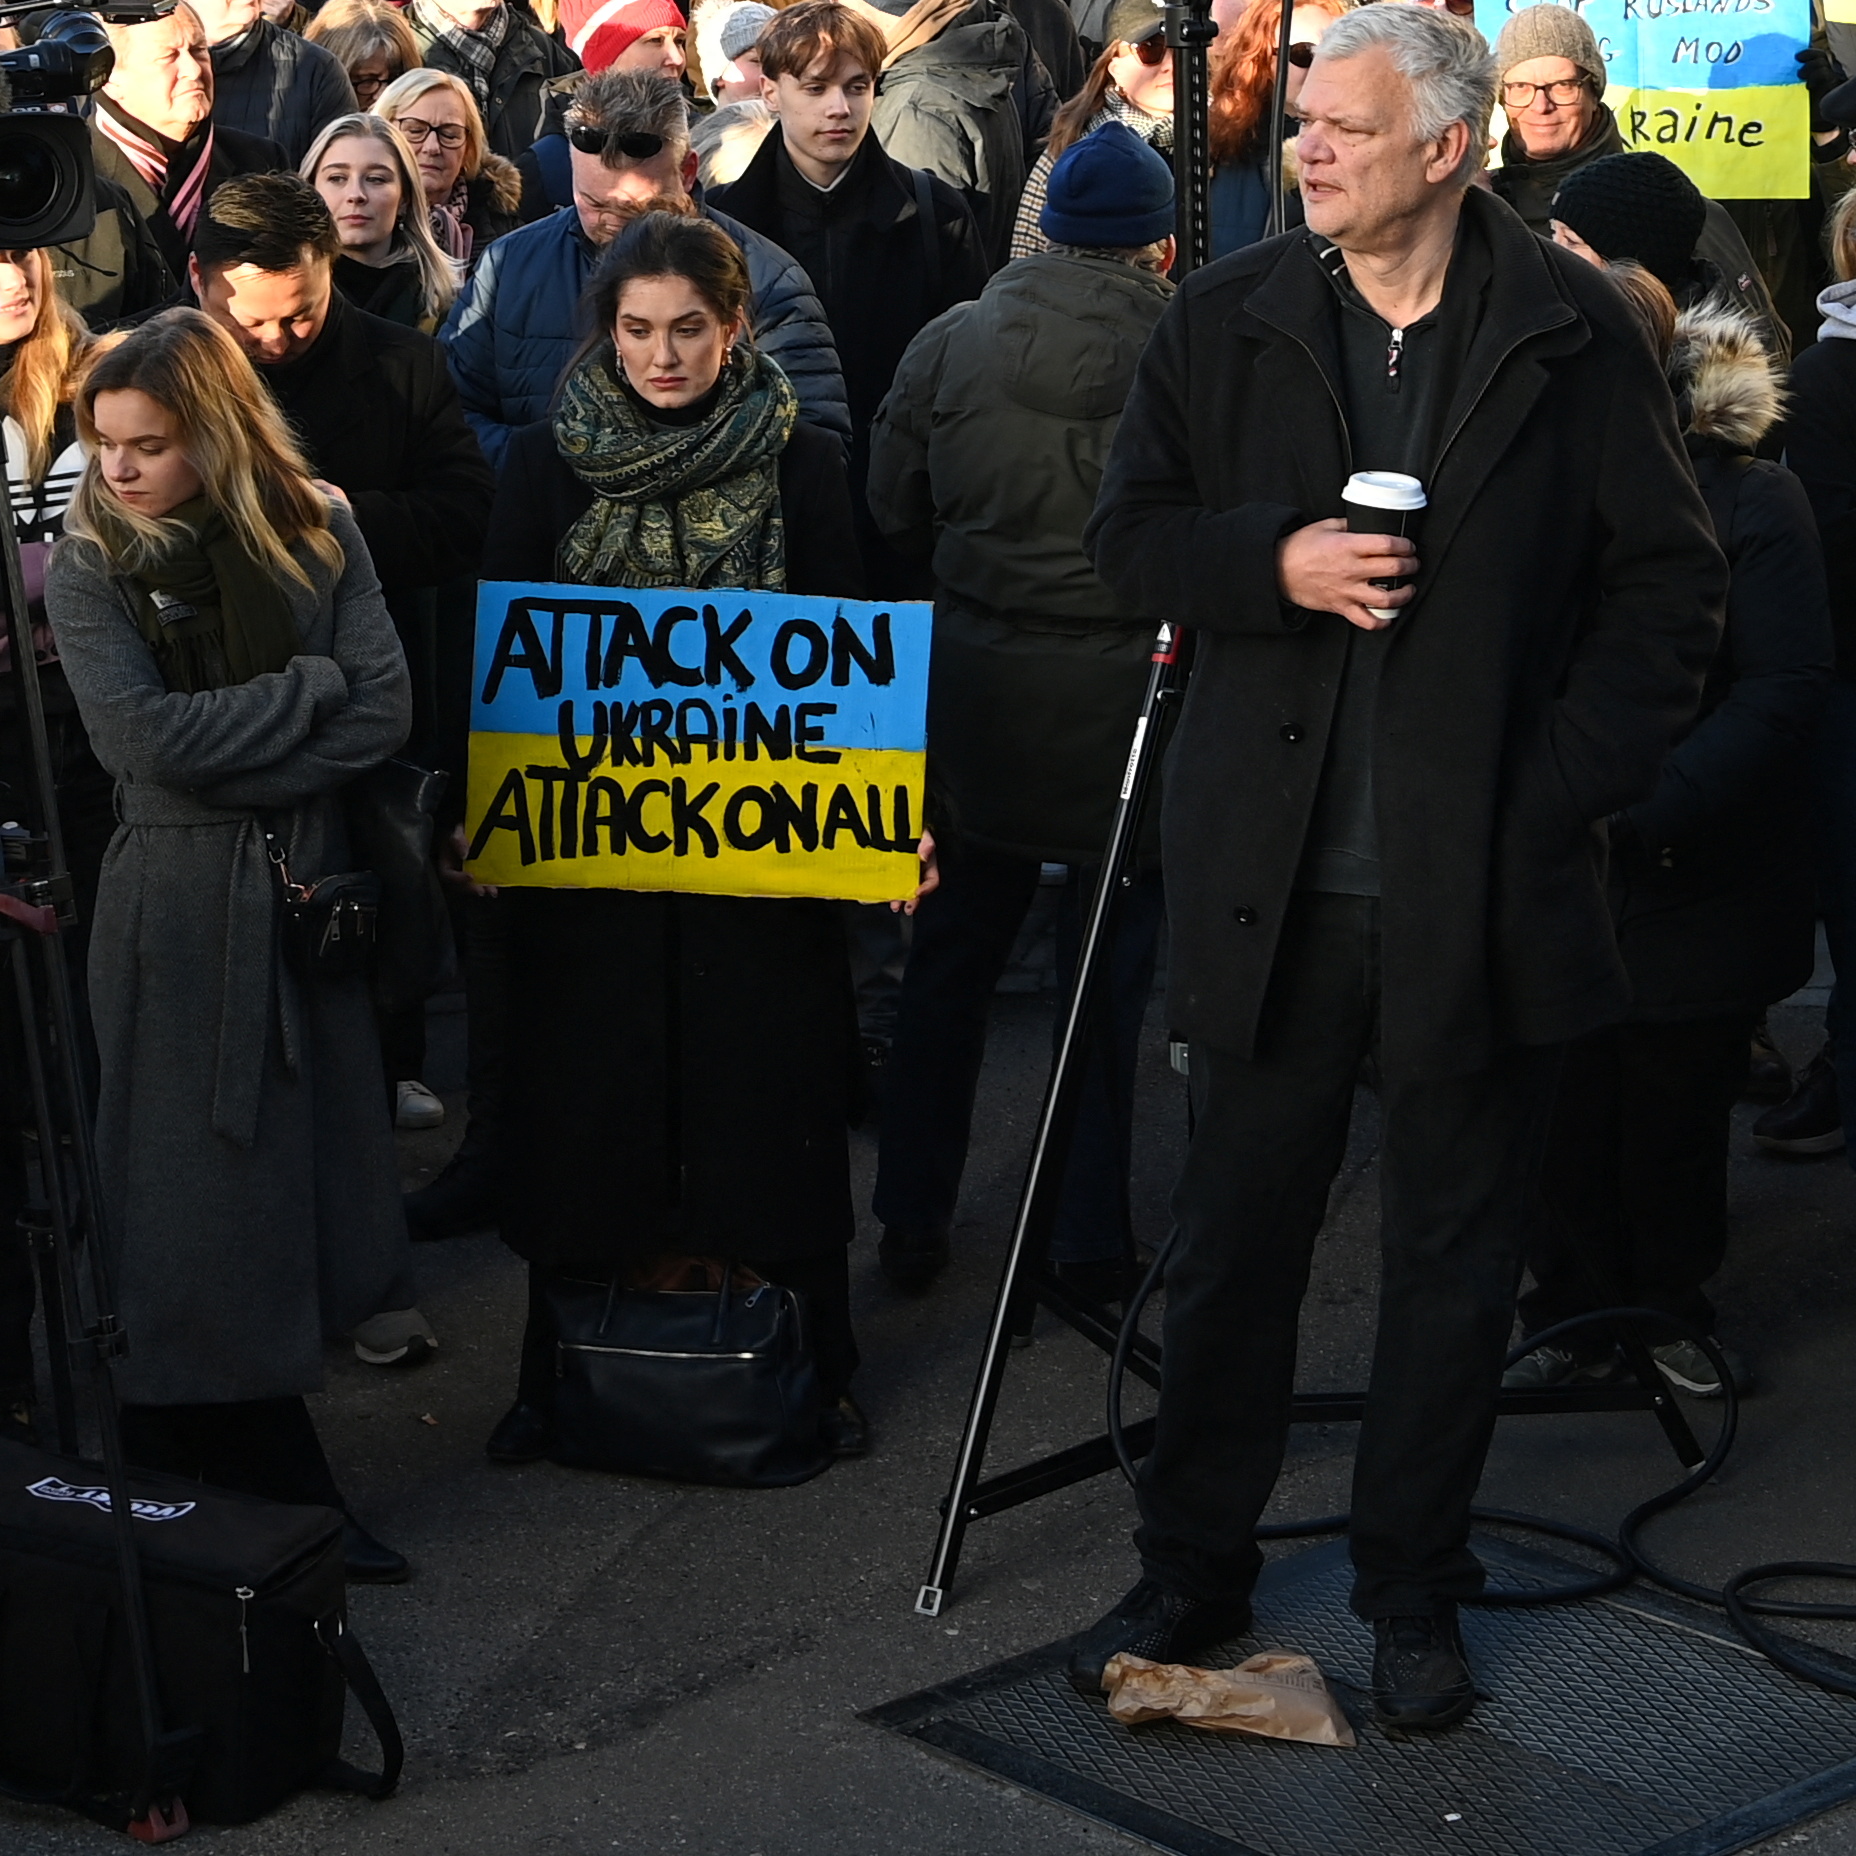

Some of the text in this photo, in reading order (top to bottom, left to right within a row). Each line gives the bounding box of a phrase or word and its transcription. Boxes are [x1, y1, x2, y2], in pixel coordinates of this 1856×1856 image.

[1672, 37, 1744, 65] MOD
[482, 595, 895, 704] ATTACK ON
[557, 692, 843, 770] UKRAINE
